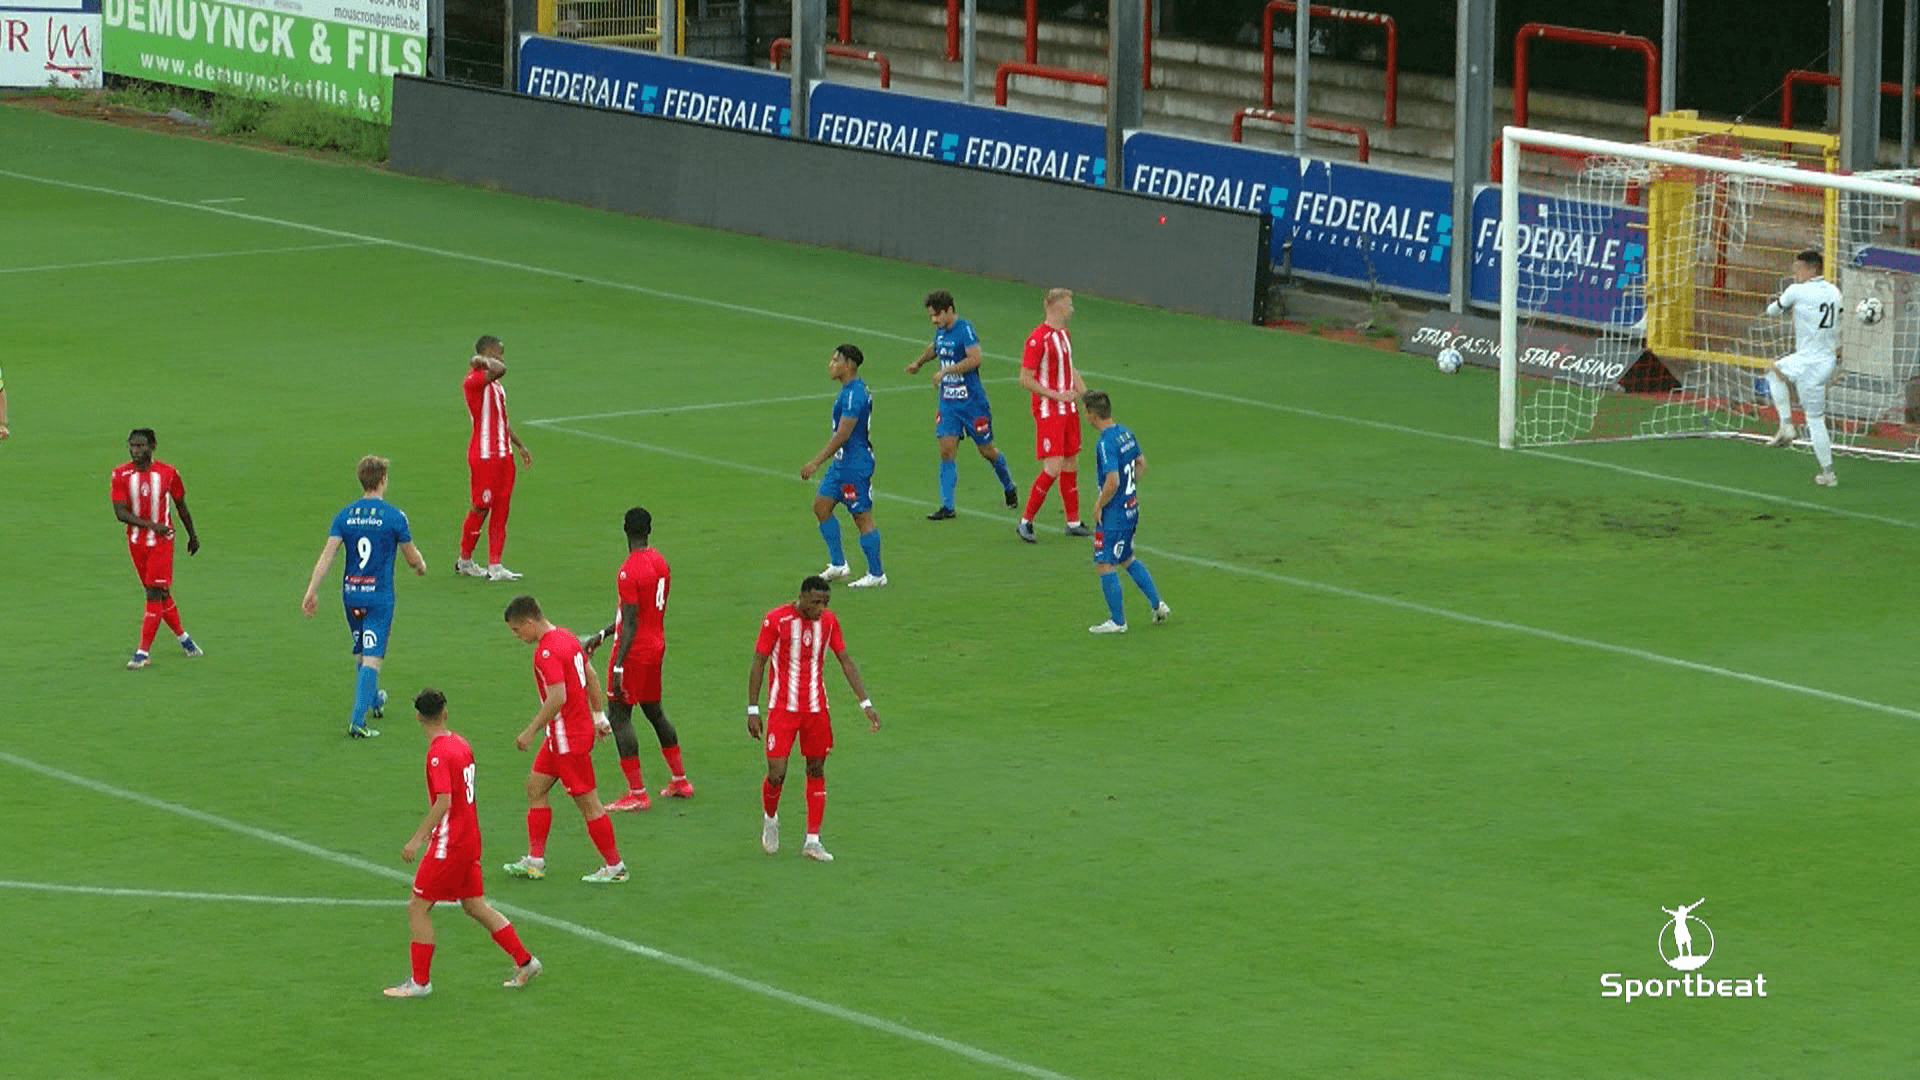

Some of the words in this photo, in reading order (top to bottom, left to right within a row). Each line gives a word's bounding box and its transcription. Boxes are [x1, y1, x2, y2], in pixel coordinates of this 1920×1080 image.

[105, 0, 295, 59] DEMUYNCK
[309, 22, 332, 65] &
[347, 27, 422, 77] FILS
[527, 65, 639, 111] FEDERALE
[663, 87, 777, 133] FEDERALE
[817, 112, 938, 159] FEDERALE
[964, 136, 1090, 183] FEDERALE
[1132, 163, 1266, 213] FEDERALE
[1294, 190, 1434, 243] FEDERALE
[1819, 302, 1835, 329] 21
[1411, 326, 1453, 350] STAR
[1450, 334, 1502, 359] CASIN
[1519, 347, 1561, 369] STAR
[1558, 354, 1624, 380] CASINO
[357, 536, 372, 569] 9
[656, 577, 666, 611] 4
